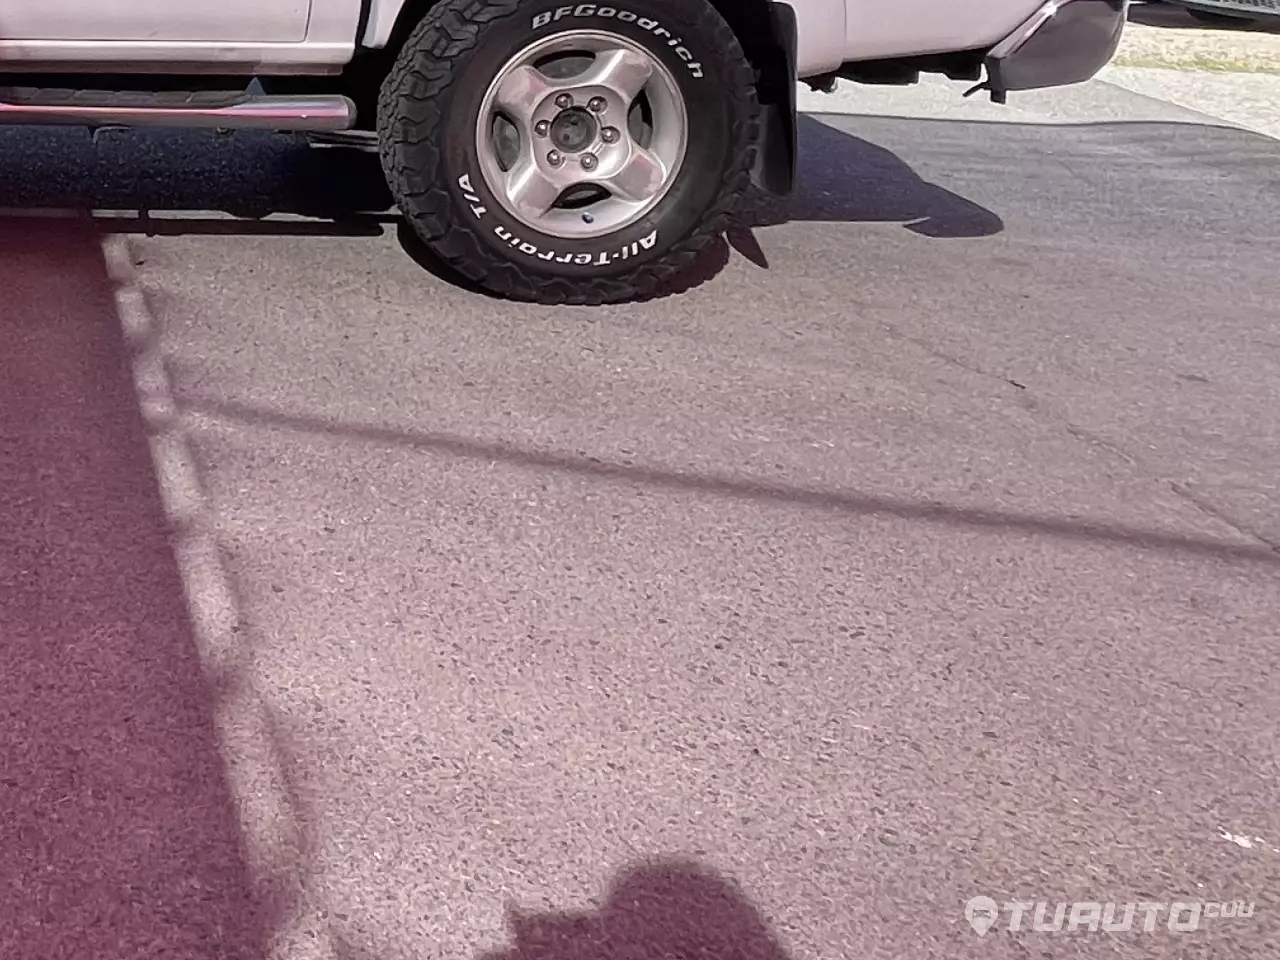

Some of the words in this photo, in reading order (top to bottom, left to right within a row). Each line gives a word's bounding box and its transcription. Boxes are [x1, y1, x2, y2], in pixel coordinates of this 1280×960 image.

[531, 3, 705, 79] BFGoodrich
[457, 173, 487, 220] T/A
[493, 228, 658, 267] All-Terrain
